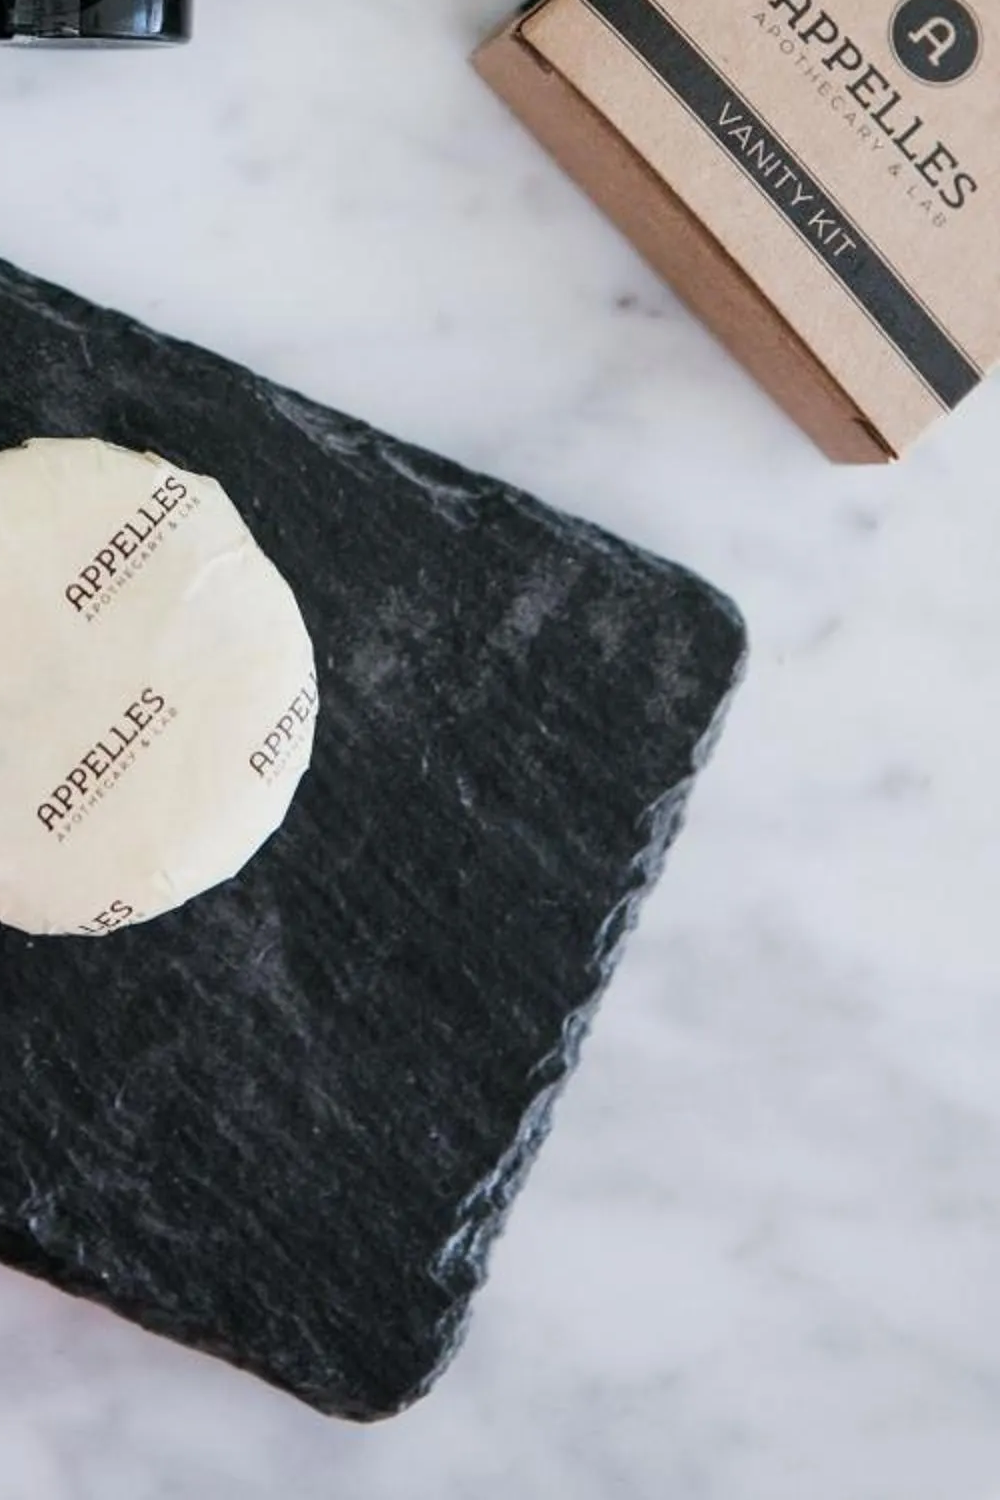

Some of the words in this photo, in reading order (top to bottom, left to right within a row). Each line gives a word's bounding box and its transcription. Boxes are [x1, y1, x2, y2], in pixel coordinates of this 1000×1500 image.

[908, 16, 957, 67] A
[715, 101, 814, 207] VANITY
[807, 208, 857, 257] KIT
[753, 11, 884, 153] APOTHECARY
[888, 163, 903, 177] &
[906, 185, 947, 229] LAB
[65, 475, 188, 613] APPELLES
[37, 686, 165, 833] APPELLES
[249, 671, 317, 778] APPEL
